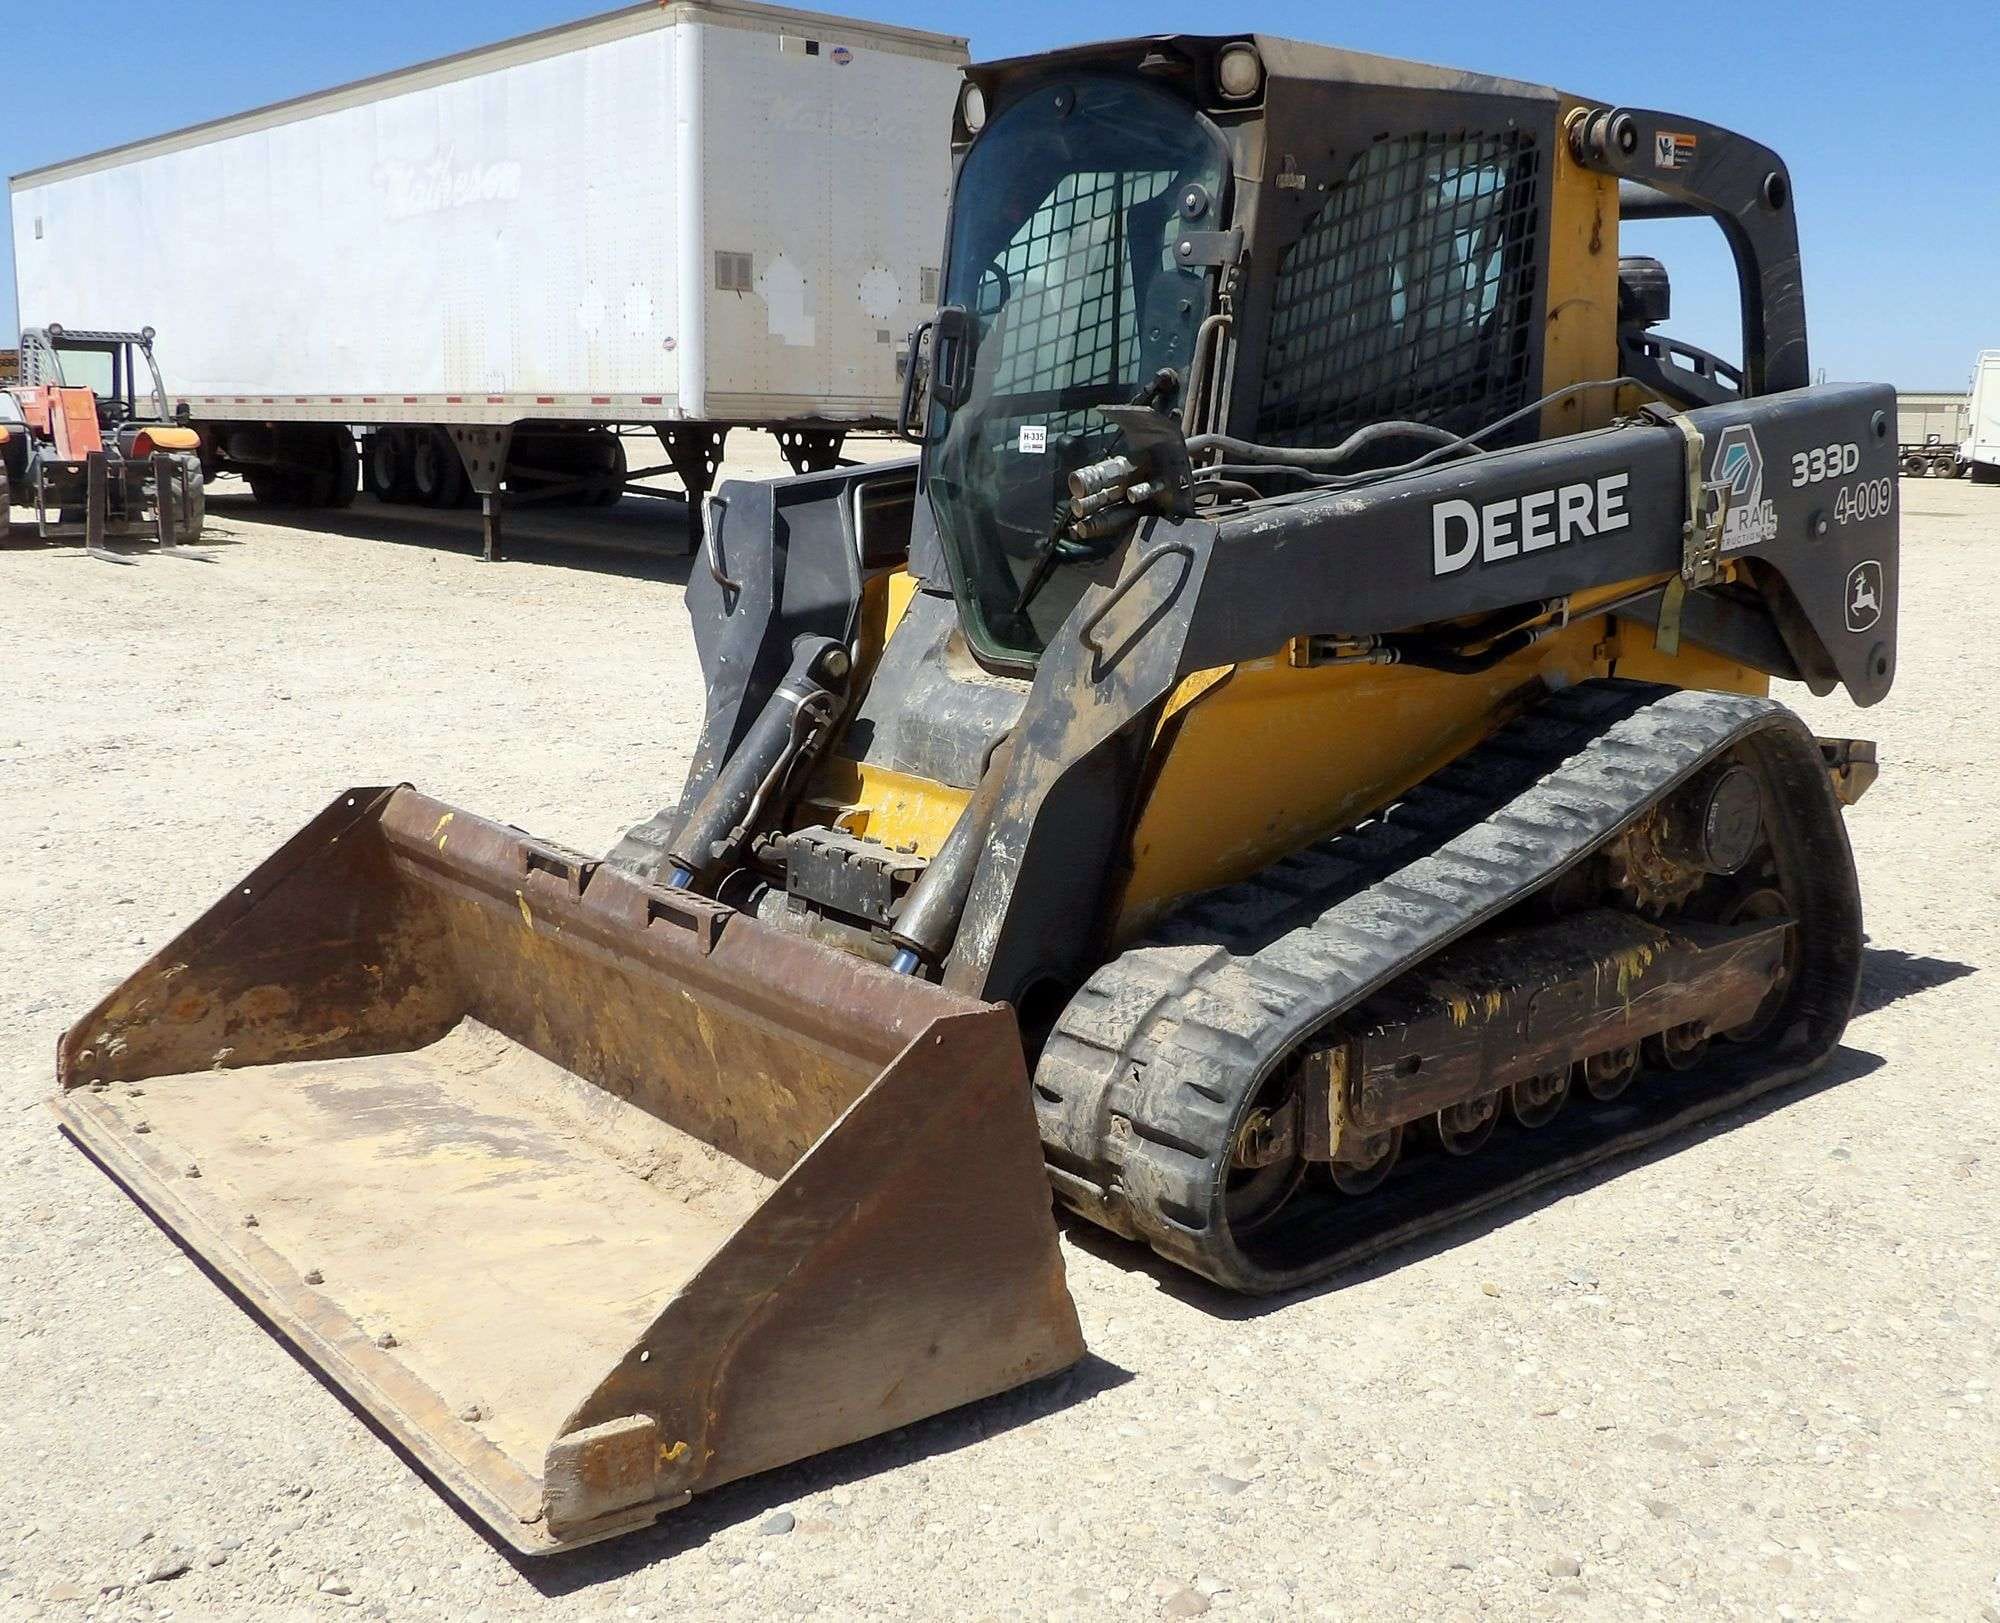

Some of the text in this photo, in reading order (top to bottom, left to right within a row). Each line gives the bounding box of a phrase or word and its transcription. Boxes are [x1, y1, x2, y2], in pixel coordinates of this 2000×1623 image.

[1023, 432, 1044, 441] H-335
[1791, 443, 1859, 487] 333D
[1739, 504, 1775, 530] RAIL
[1834, 477, 1891, 524] 4-009
[1432, 472, 1629, 575] DEERE
